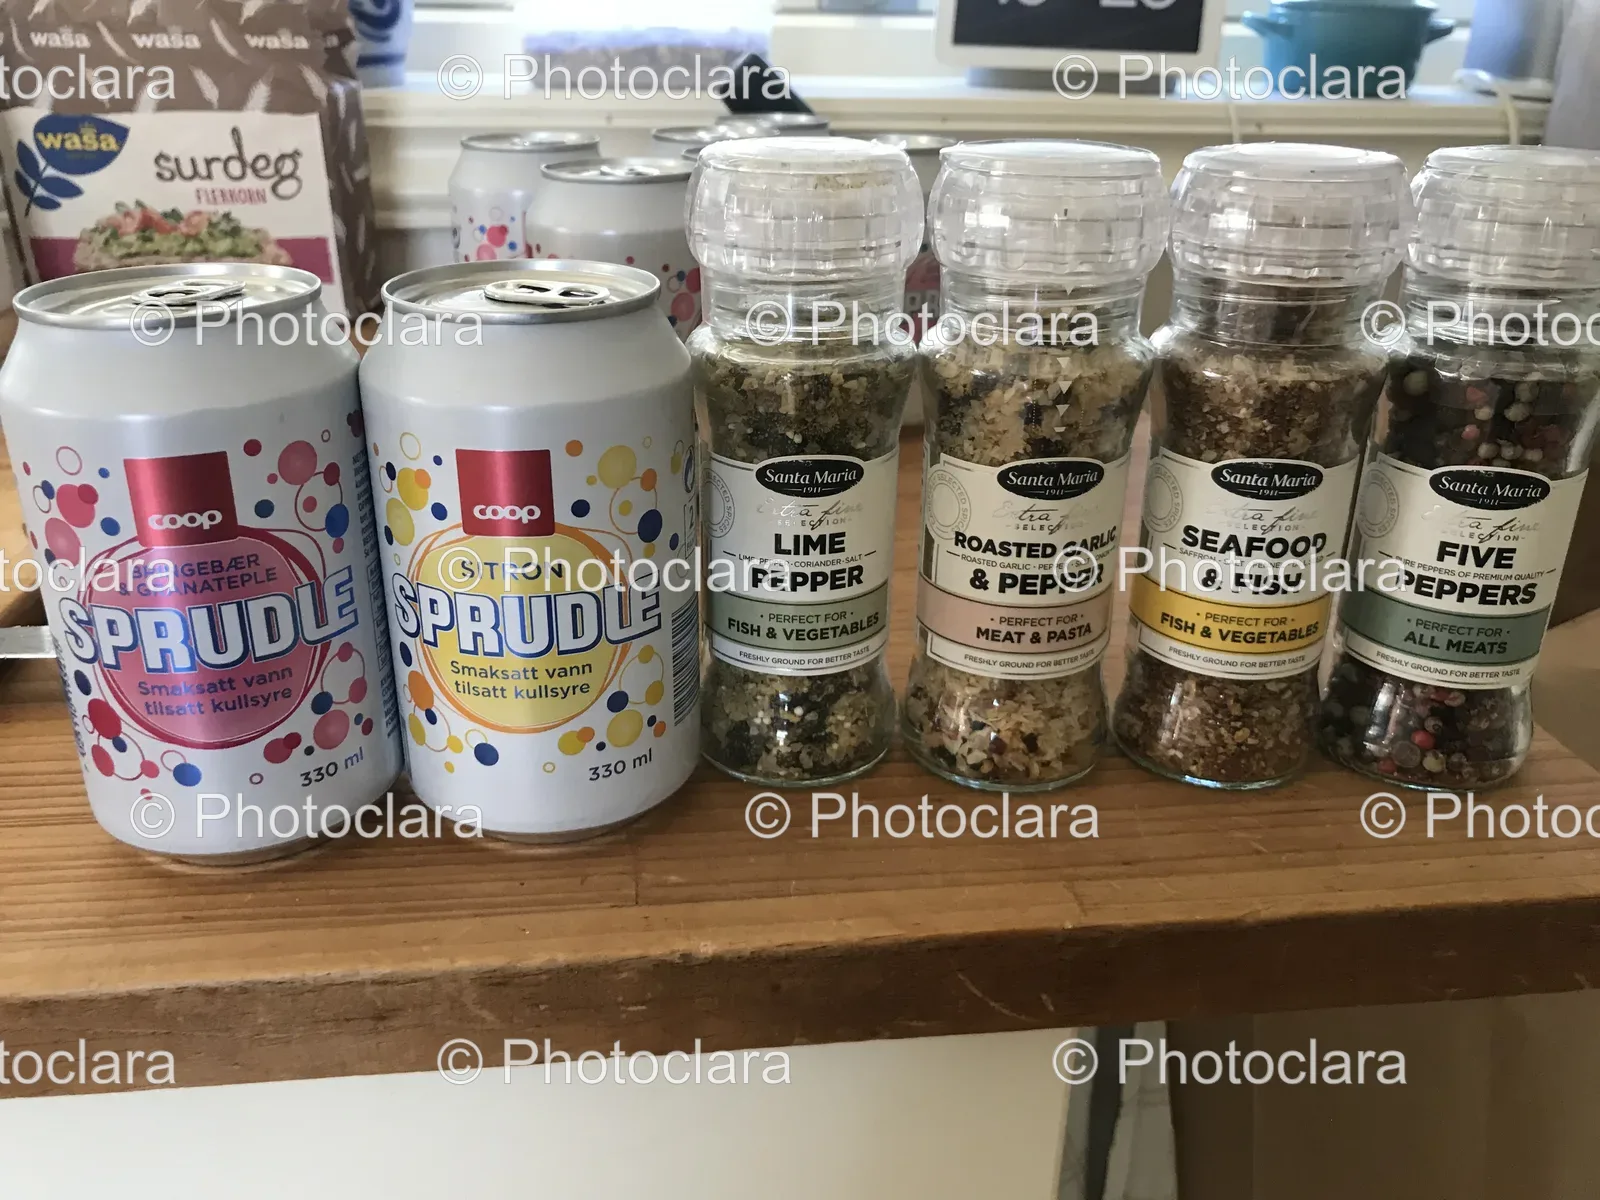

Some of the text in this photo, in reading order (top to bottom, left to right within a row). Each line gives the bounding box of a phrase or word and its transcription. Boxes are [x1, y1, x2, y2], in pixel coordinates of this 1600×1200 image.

[154, 126, 302, 200] surdeg
[765, 468, 857, 484] Santa Maria
[1007, 470, 1098, 487] Santa Maria
[1220, 469, 1316, 487] Santa Maria
[1439, 476, 1541, 498] Santa Maria
[803, 486, 822, 494] 1911
[1479, 498, 1499, 506] 1911
[148, 509, 222, 530] coop
[472, 504, 541, 524] coop
[774, 532, 846, 556] LIME
[954, 526, 1117, 558] ROASTED GARLIC
[1181, 525, 1327, 558] SEAFOOD
[794, 558, 842, 568] CORIANDER
[845, 554, 863, 564] SALT
[961, 554, 997, 568] ROASTED
[999, 562, 1031, 571] GARLIC
[1436, 541, 1517, 569] FIVE
[461, 560, 565, 581] SITRON
[751, 565, 864, 592] PEPPER
[969, 563, 1104, 595] & PEPPER
[1417, 563, 1455, 577] PEPPERS
[1473, 572, 1513, 581] PREMIUM
[1514, 571, 1545, 581] QUALITY
[1201, 569, 1302, 595] & FISH
[1396, 571, 1538, 606] PEPPERS
[59, 565, 359, 675] SPRUDLE
[392, 568, 662, 659] SPRUDLE
[768, 611, 847, 624] PERFECT FOR
[1000, 613, 1078, 627] PERFECT FOR
[1205, 612, 1287, 626] PERFECT FOR
[728, 611, 880, 641] FISH & VEGETABLES
[976, 623, 1092, 644] MEAT & PASTA
[1160, 612, 1319, 644] FISH & VEGETABLES
[1415, 618, 1503, 637] PERFECT FOR
[1404, 631, 1508, 655] ALL MEATS
[739, 645, 870, 666] FRESHLY GROUND FOR BETTER TASTE
[964, 653, 997, 667] FRESHLY
[999, 660, 1034, 669] GROUND
[1036, 660, 1052, 668] FOR
[1053, 656, 1079, 667] BETTER
[1169, 646, 1201, 661] FRESHLY
[1203, 656, 1238, 668] GROUND
[1240, 660, 1257, 669] FOR
[1258, 659, 1287, 669] BETTER
[1376, 651, 1409, 667] FRESHLY
[1411, 663, 1448, 676] GROUND
[1450, 670, 1467, 678] FOR
[1469, 671, 1499, 679] BETTER
[138, 666, 293, 697] Smaksatt vann
[450, 660, 592, 681] Smaksatt vann
[144, 686, 293, 717] tilsatt kullsyre
[454, 680, 591, 701] tilsatt kullsyre
[300, 747, 364, 788] 330 ml
[588, 747, 653, 782] 330 ml
